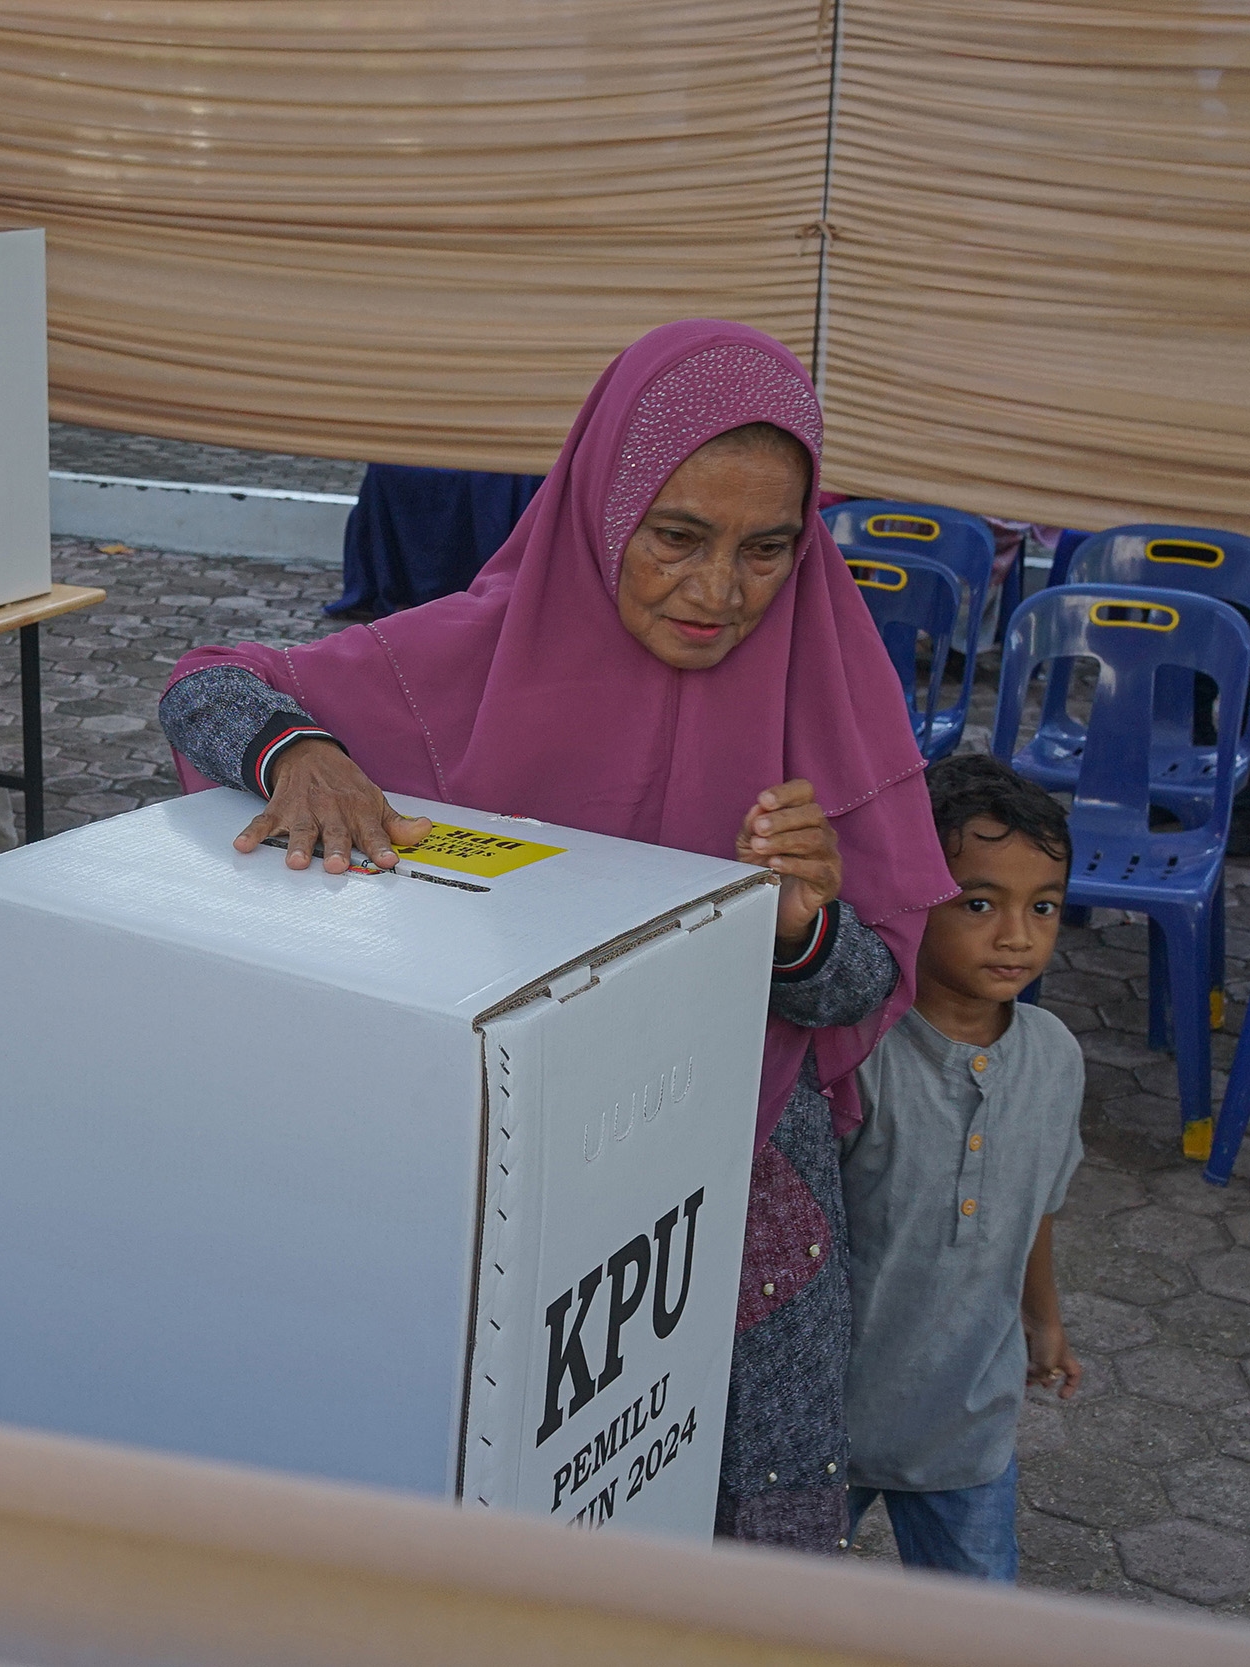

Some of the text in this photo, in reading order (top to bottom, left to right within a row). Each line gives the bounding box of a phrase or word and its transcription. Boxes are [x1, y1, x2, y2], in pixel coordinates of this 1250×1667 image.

[445, 829, 527, 850] DPR
[535, 1185, 705, 1449] KPU
[550, 1371, 671, 1514] PEMILU
[626, 1404, 698, 1503] 2024
